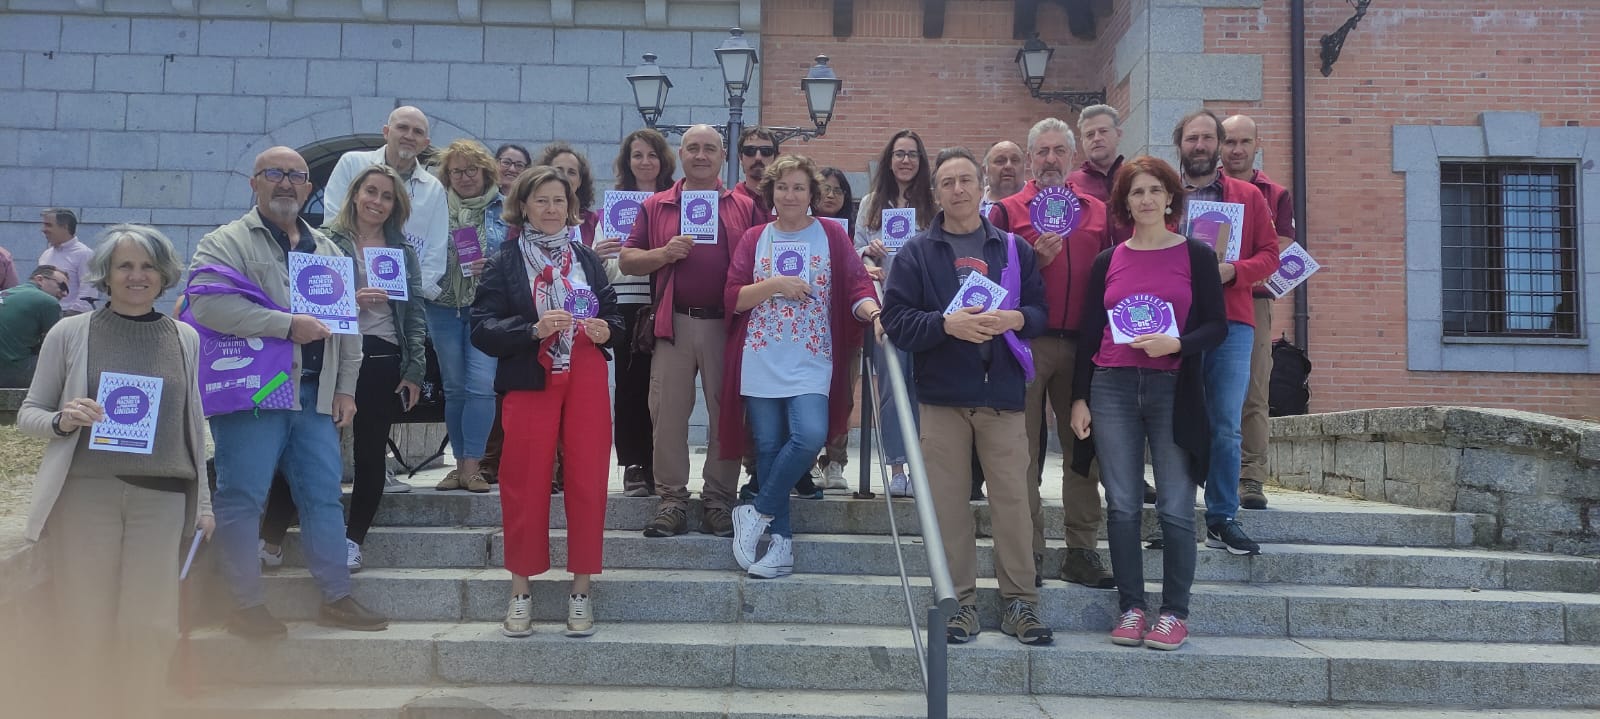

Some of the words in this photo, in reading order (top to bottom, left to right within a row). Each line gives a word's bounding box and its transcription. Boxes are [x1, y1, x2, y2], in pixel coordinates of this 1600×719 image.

[308, 287, 334, 295] UNIDAS
[1134, 294, 1168, 311] VIOLETA
[221, 348, 241, 356] VIVAS
[113, 407, 139, 415] UNIDAS
